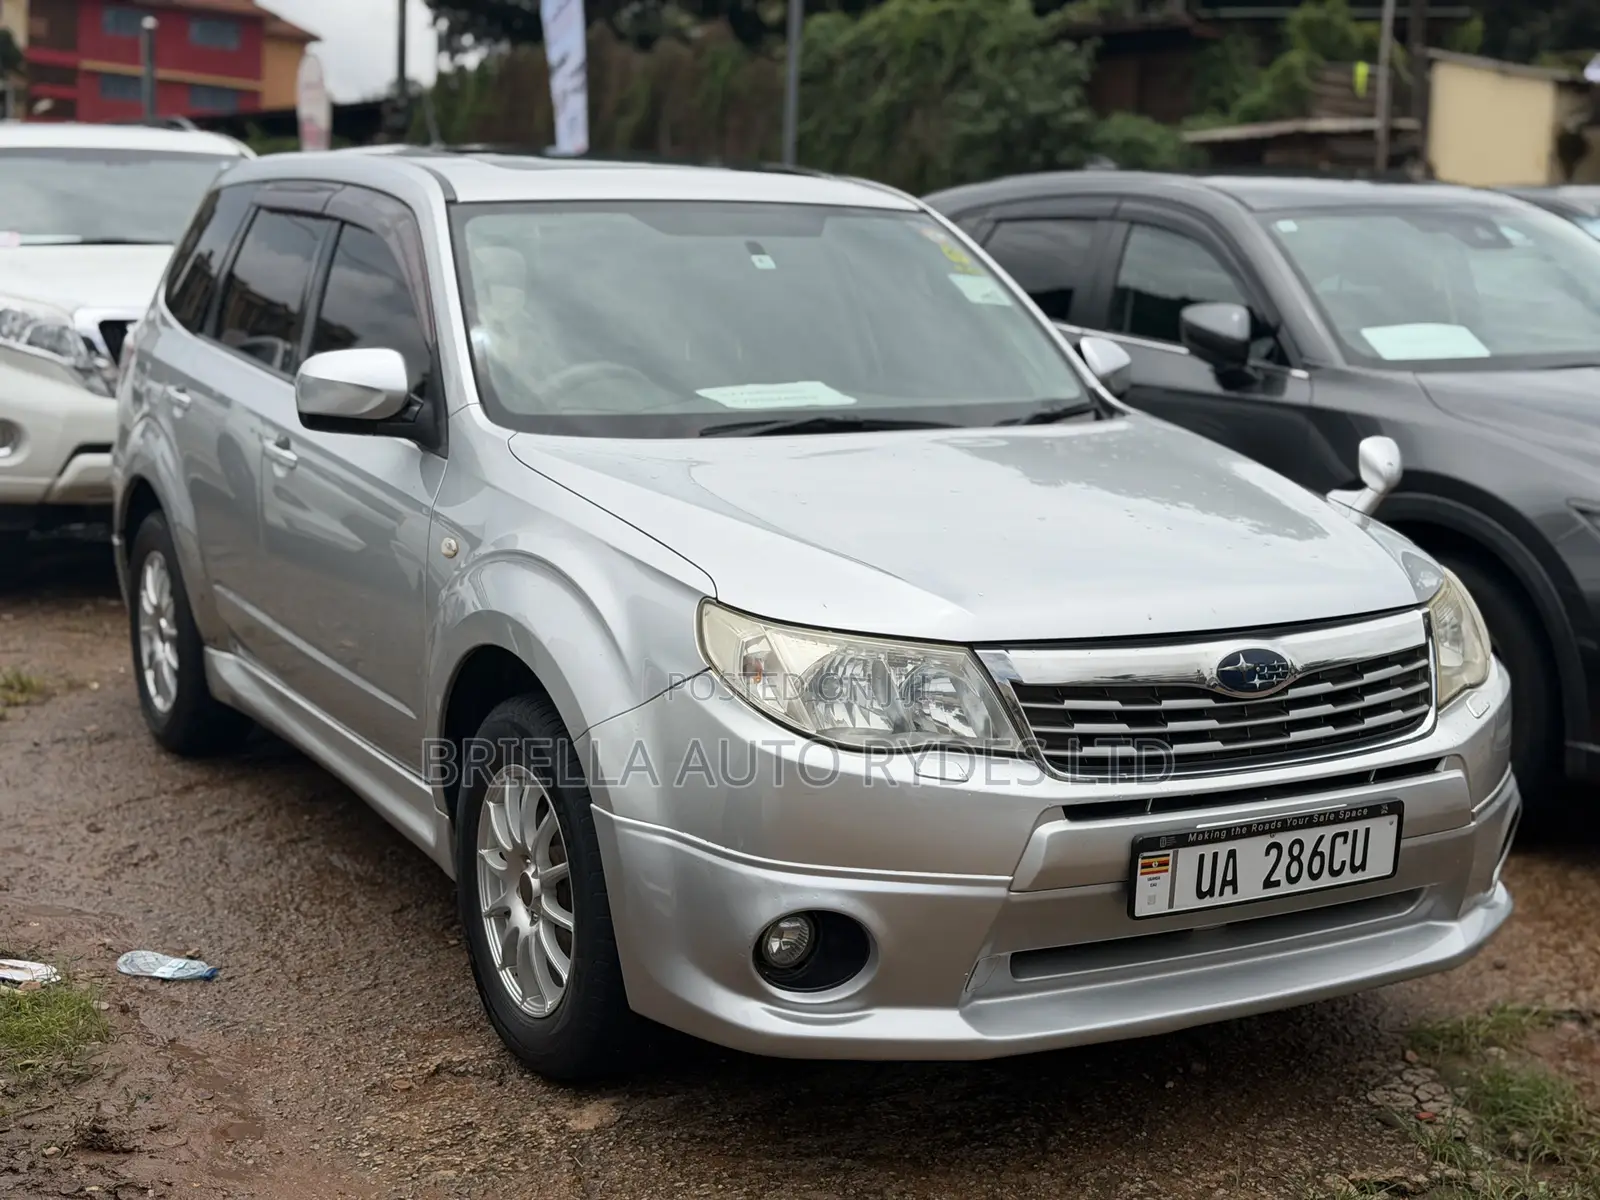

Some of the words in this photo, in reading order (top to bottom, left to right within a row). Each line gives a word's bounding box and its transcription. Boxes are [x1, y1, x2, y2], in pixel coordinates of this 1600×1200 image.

[1187, 829, 1227, 843] Making
[1231, 825, 1247, 836] the
[1251, 820, 1282, 832] Roads
[1286, 815, 1310, 827] Your
[1312, 811, 1335, 823] Safe
[1338, 808, 1368, 820] Space
[1195, 848, 1239, 900] UA
[1262, 826, 1371, 890] 286CU
